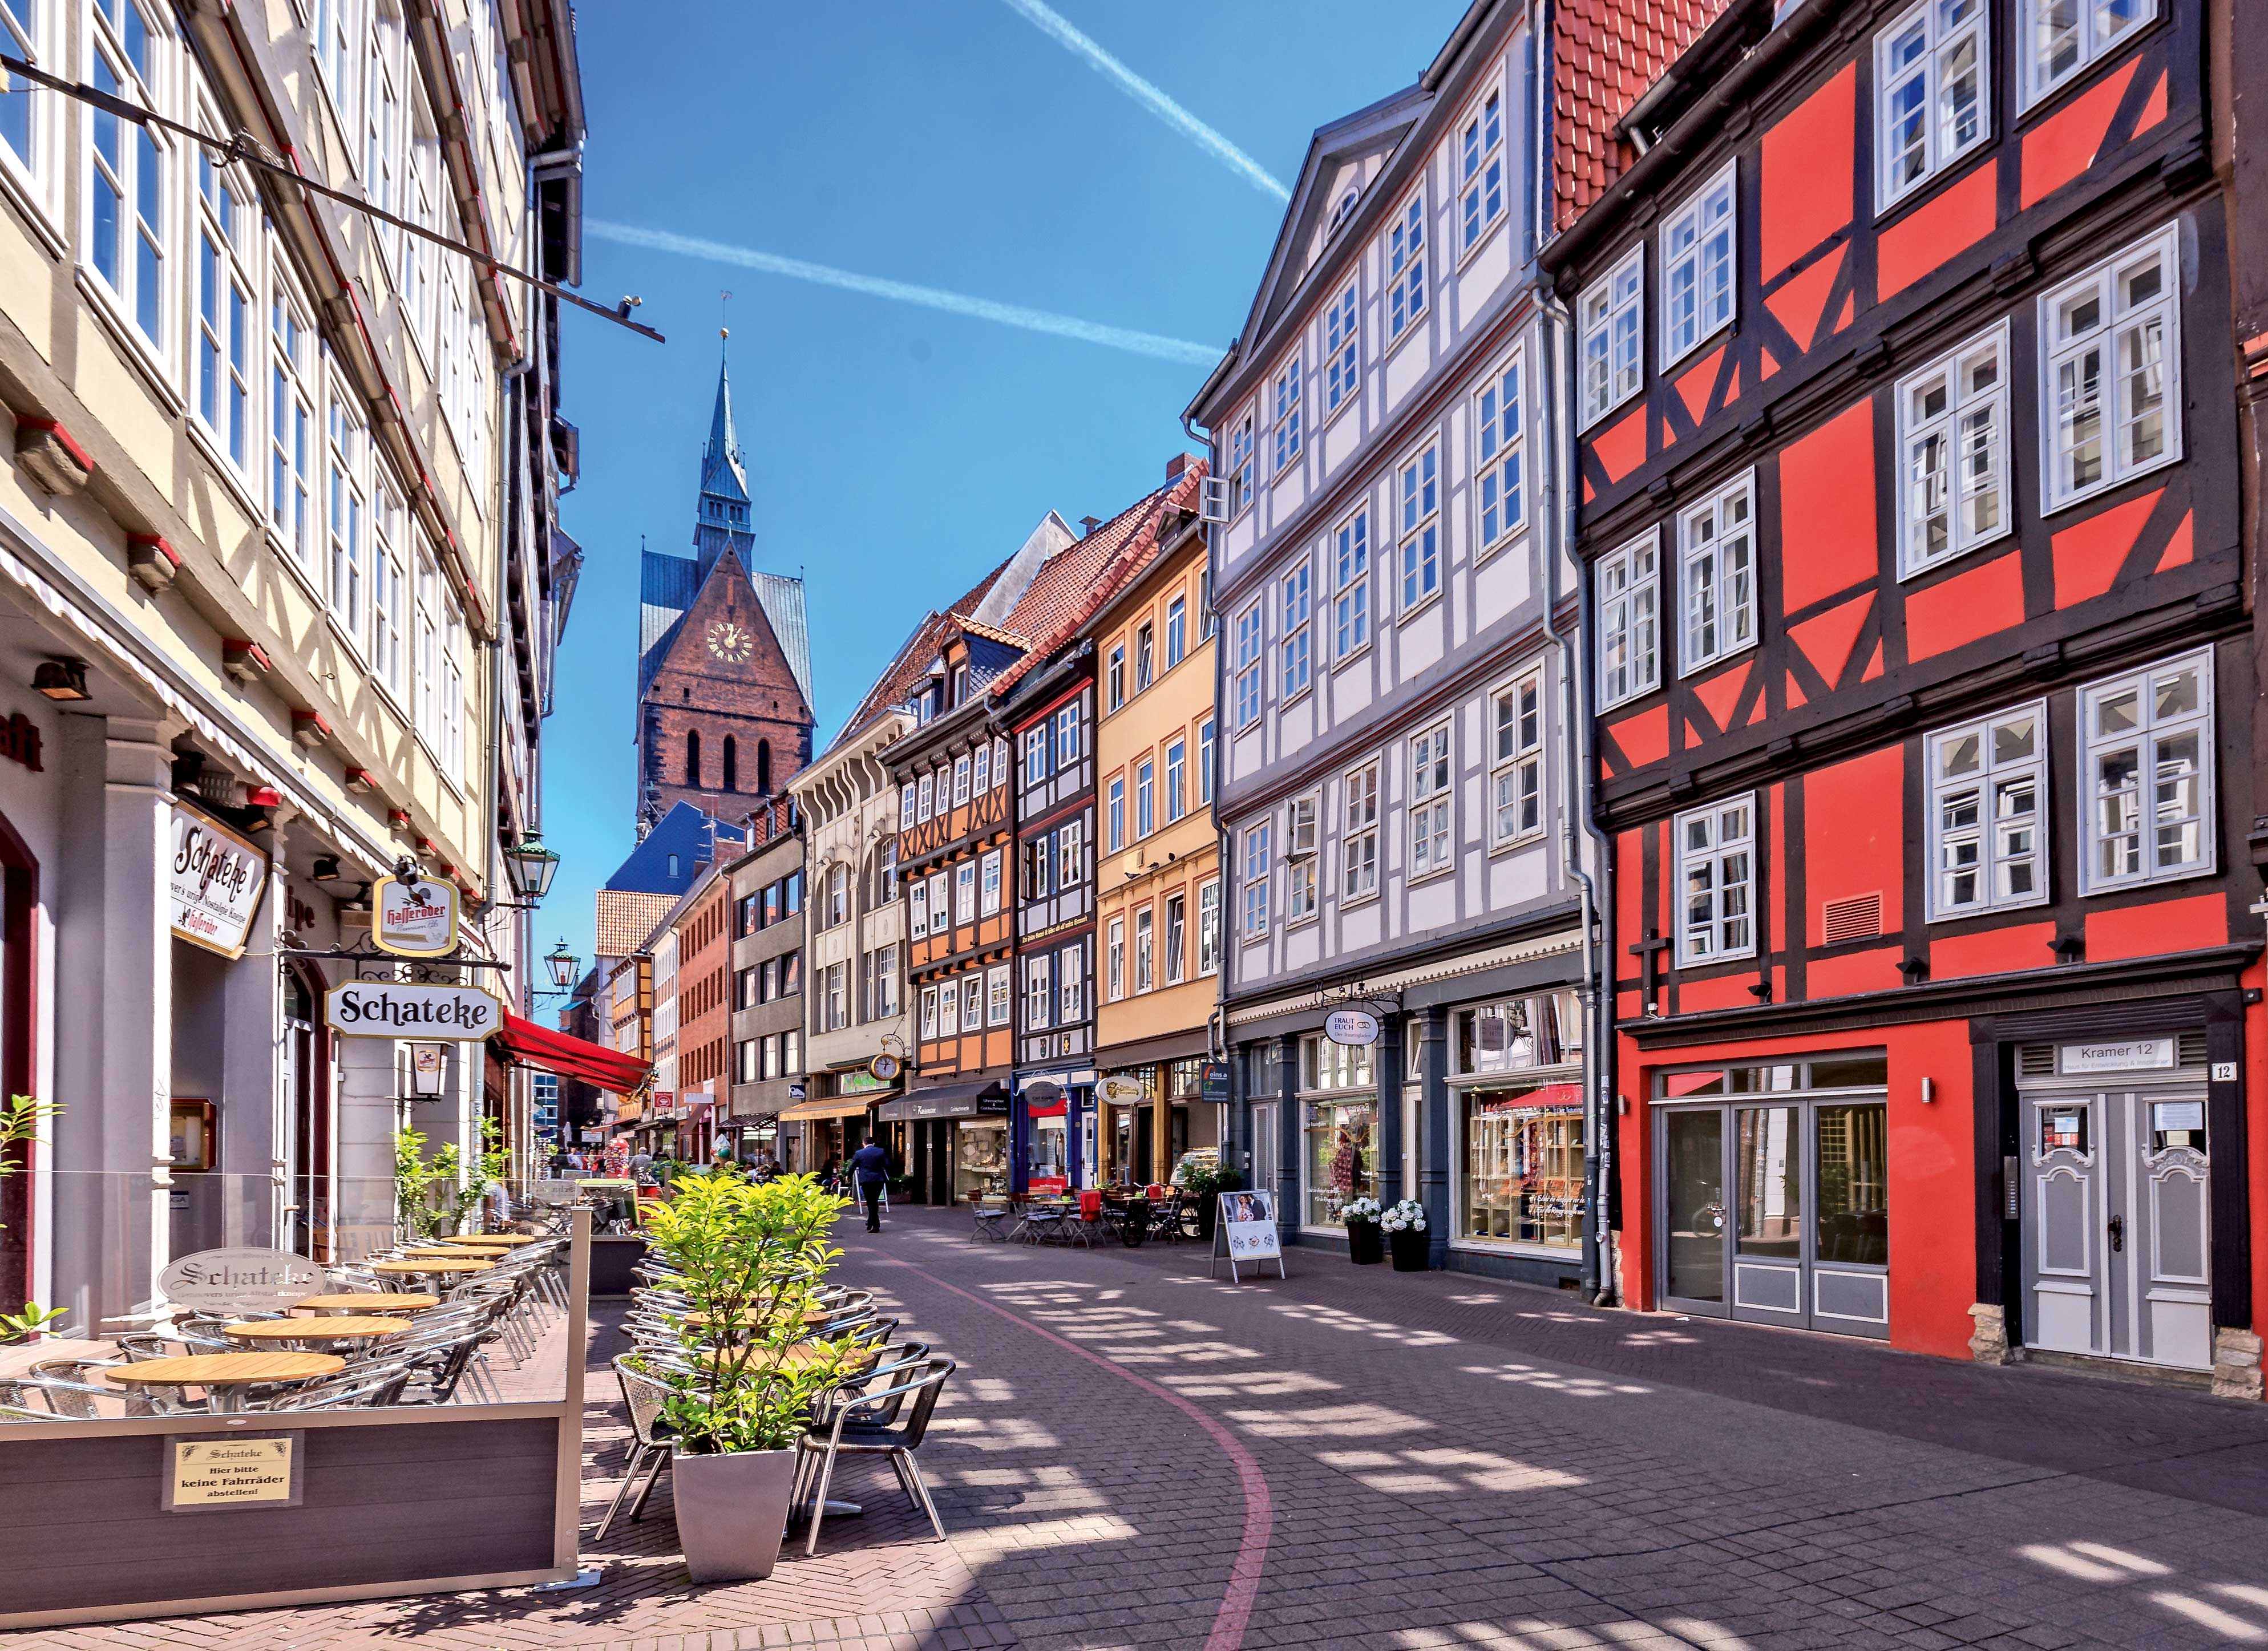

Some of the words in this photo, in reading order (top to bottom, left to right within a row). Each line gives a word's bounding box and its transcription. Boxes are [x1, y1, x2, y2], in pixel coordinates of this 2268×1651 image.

[175, 826, 246, 903] Schateke
[187, 889, 202, 904] urige
[203, 895, 228, 916] Nostalgie
[228, 908, 246, 925] Kneipe
[340, 990, 487, 1029] Schateke
[2082, 1047, 2131, 1058] Kramer
[2136, 1044, 2153, 1055] 12
[2218, 1066, 2230, 1078] 12
[169, 1262, 316, 1290] Schateke
[206, 1449, 262, 1460] Schateke
[223, 1476, 285, 1486] Fahrräder
[207, 1488, 258, 1497] abstellen!
